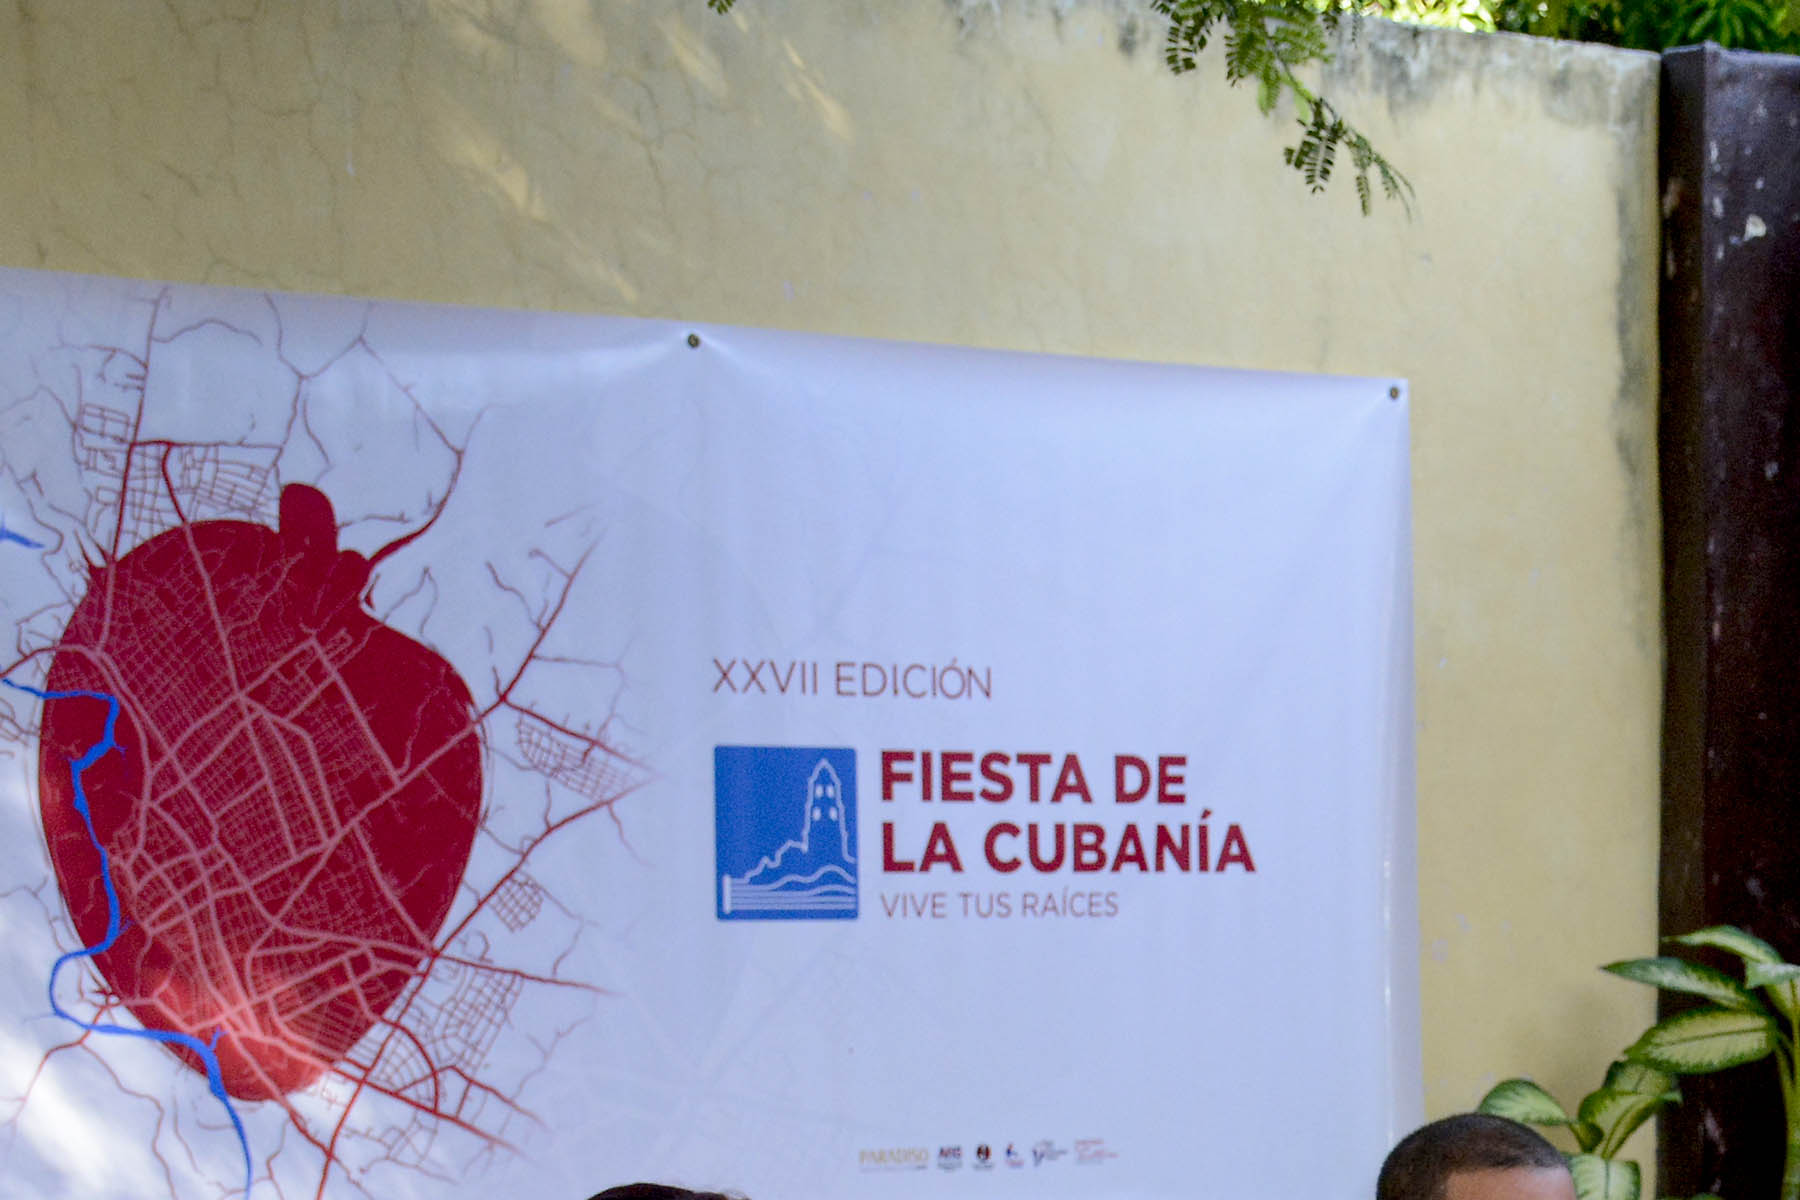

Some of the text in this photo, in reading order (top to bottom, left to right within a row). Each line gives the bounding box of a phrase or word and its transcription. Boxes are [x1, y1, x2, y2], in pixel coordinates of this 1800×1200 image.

[712, 658, 992, 699] XXVII EDICIÓN
[881, 751, 1188, 804] FIESTA DE
[882, 809, 1257, 873] LA CUBANÍA
[880, 887, 1119, 919] VIVE TUS RAÍCES
